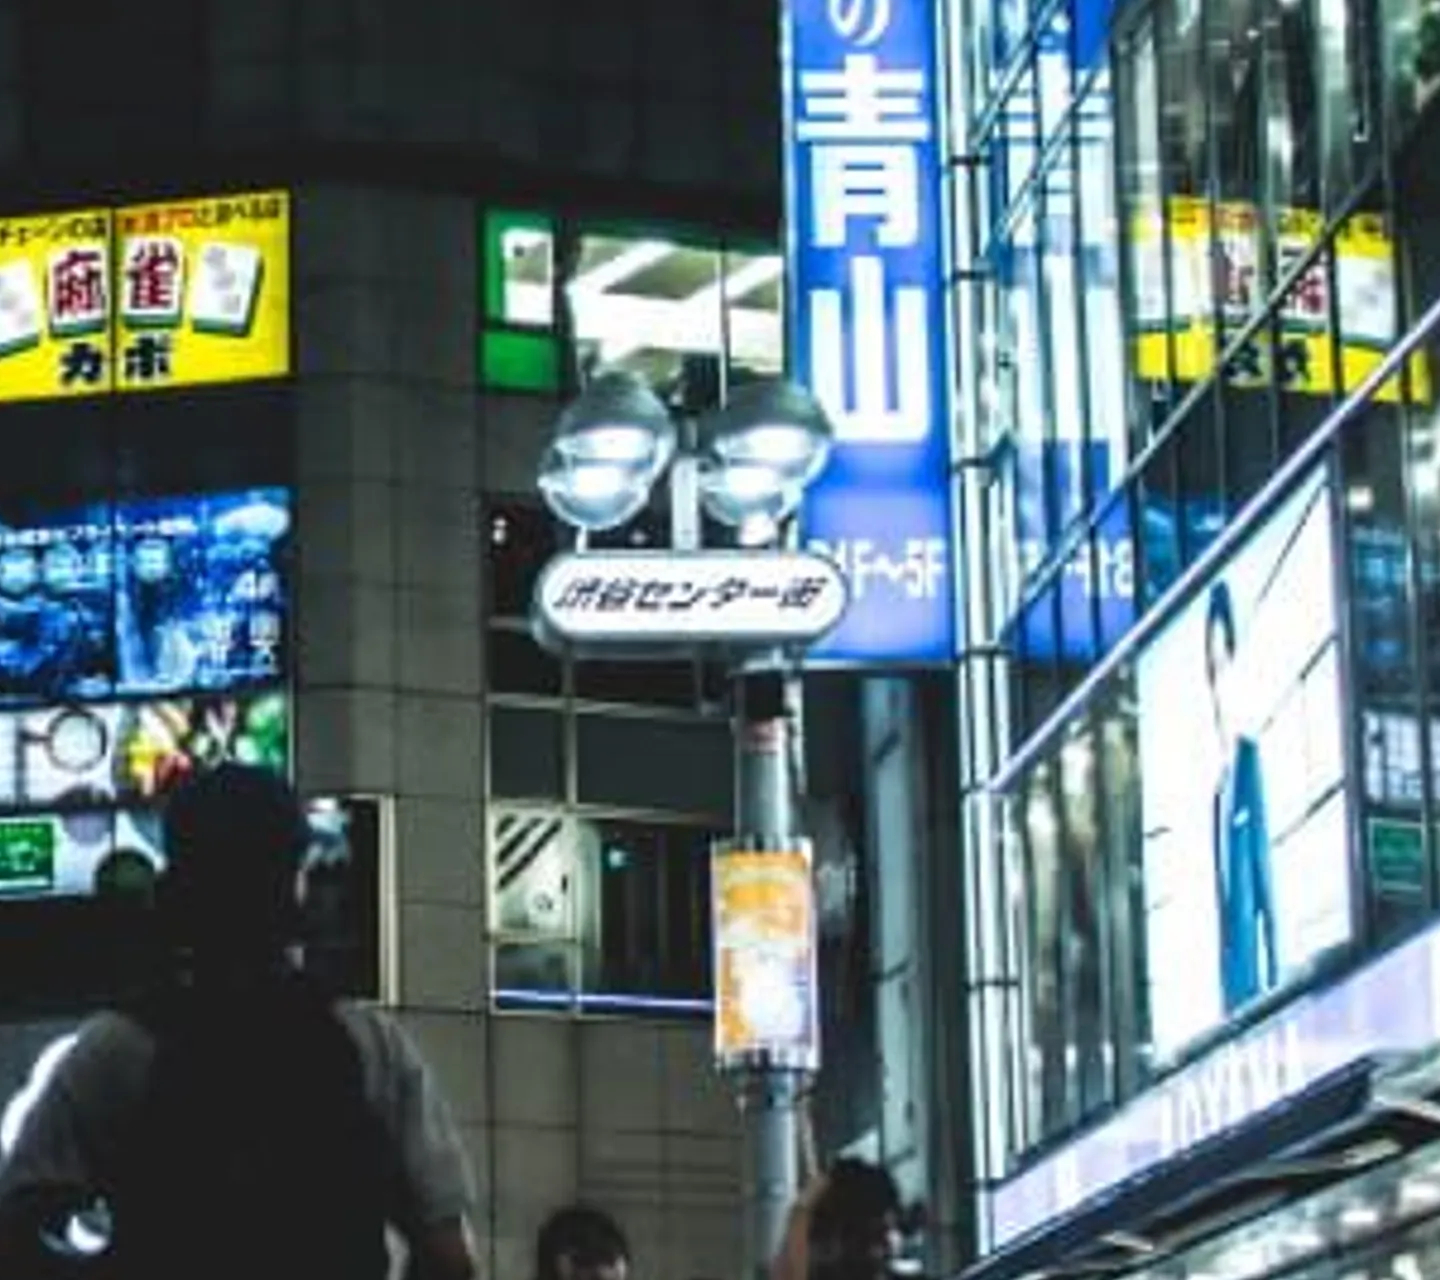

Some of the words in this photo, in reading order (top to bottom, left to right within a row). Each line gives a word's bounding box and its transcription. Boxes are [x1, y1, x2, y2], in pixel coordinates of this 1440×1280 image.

[52, 239, 180, 318] 麻雀
[58, 332, 172, 384] カボ
[552, 575, 830, 615] 渋谷センター街
